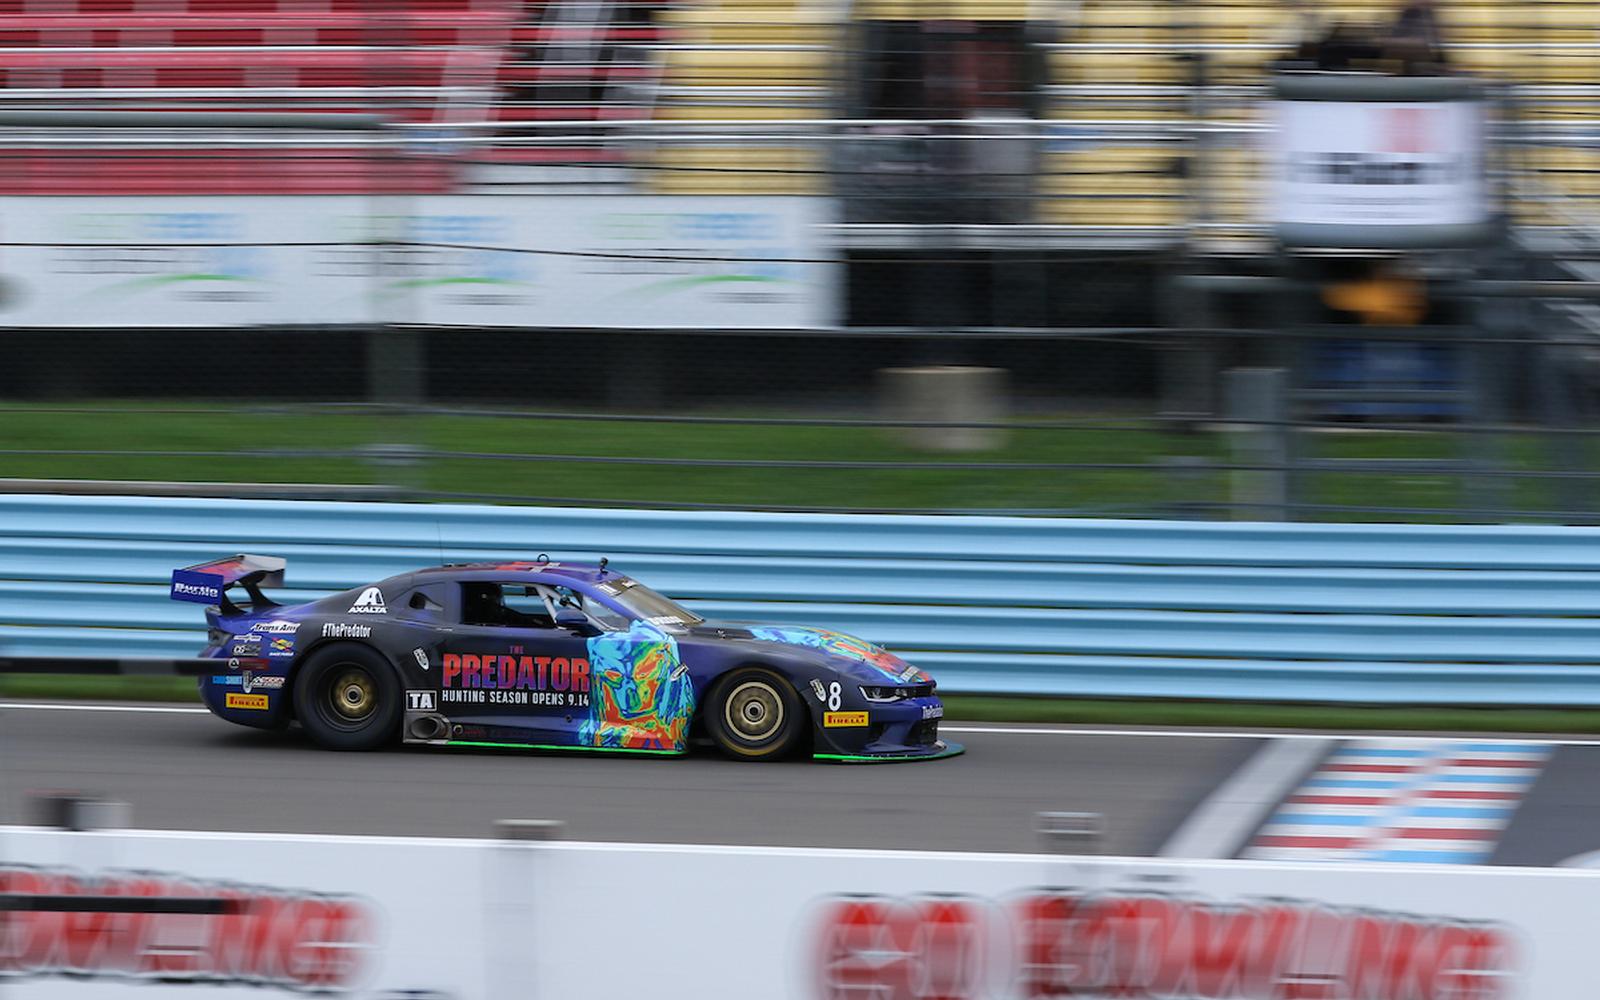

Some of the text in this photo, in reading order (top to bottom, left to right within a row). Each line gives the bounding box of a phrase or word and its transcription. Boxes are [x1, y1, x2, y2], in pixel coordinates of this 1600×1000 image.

[322, 623, 371, 638] #ThePredator
[510, 645, 525, 654] THE
[443, 653, 590, 692] PREDATOR
[229, 696, 265, 707] PIRELLI
[410, 693, 432, 708] TA
[442, 690, 589, 707] HUNTING SEASON OPENS 9.14
[828, 681, 841, 711] 8
[828, 714, 865, 724] PIRELLI
